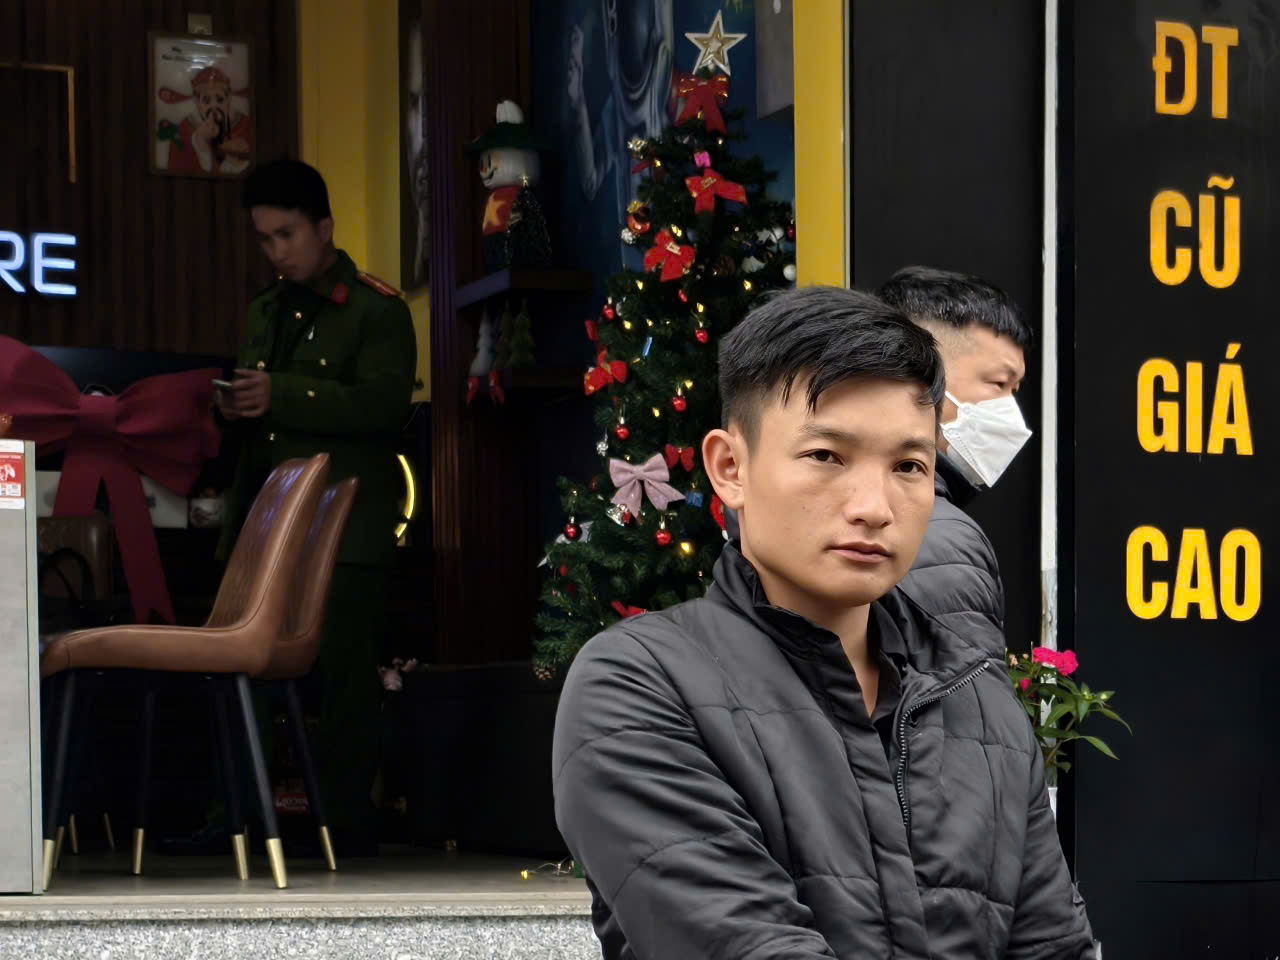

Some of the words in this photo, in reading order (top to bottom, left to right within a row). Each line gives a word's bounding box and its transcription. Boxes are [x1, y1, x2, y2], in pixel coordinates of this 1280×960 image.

[1152, 20, 1239, 119] ĐT
[0, 230, 77, 296] RE
[1150, 174, 1241, 289] CŨ
[1137, 342, 1254, 456] GIÁ
[1126, 525, 1261, 622] CAO
